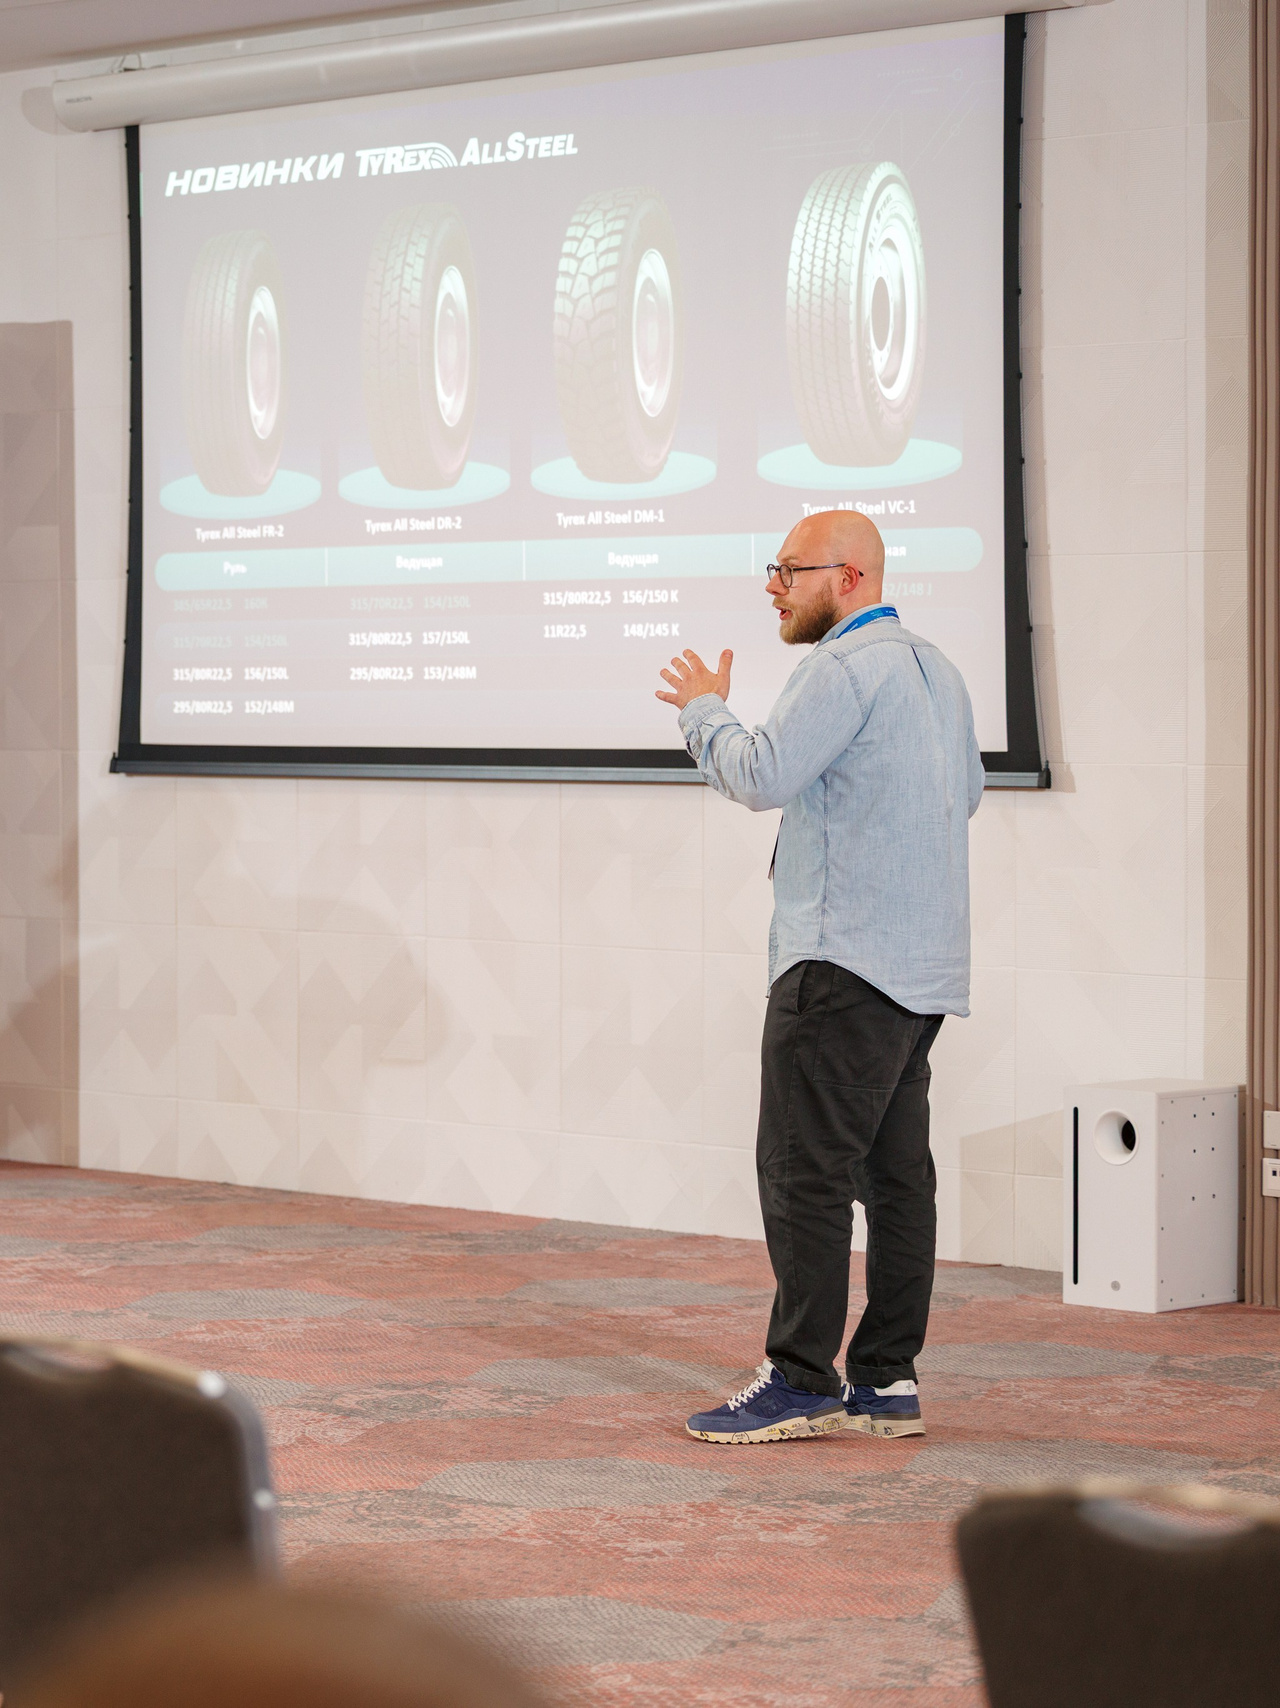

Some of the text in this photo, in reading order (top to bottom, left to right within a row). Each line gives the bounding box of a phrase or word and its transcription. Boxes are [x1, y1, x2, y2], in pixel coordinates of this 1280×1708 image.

[165, 152, 345, 197] НОВИНКИ
[855, 500, 885, 515] Steel
[888, 499, 916, 514] VC-1
[365, 516, 462, 535] Tyrex All Steel DR-2
[556, 509, 665, 529] Tyrex All Steel DM-1
[195, 525, 284, 543] Tyrex All Steel FR-2
[607, 552, 659, 568] Ведущая
[543, 589, 679, 607] 315/80R22,5 156/150 K
[544, 624, 587, 640] 11R22,5
[671, 623, 680, 637] K
